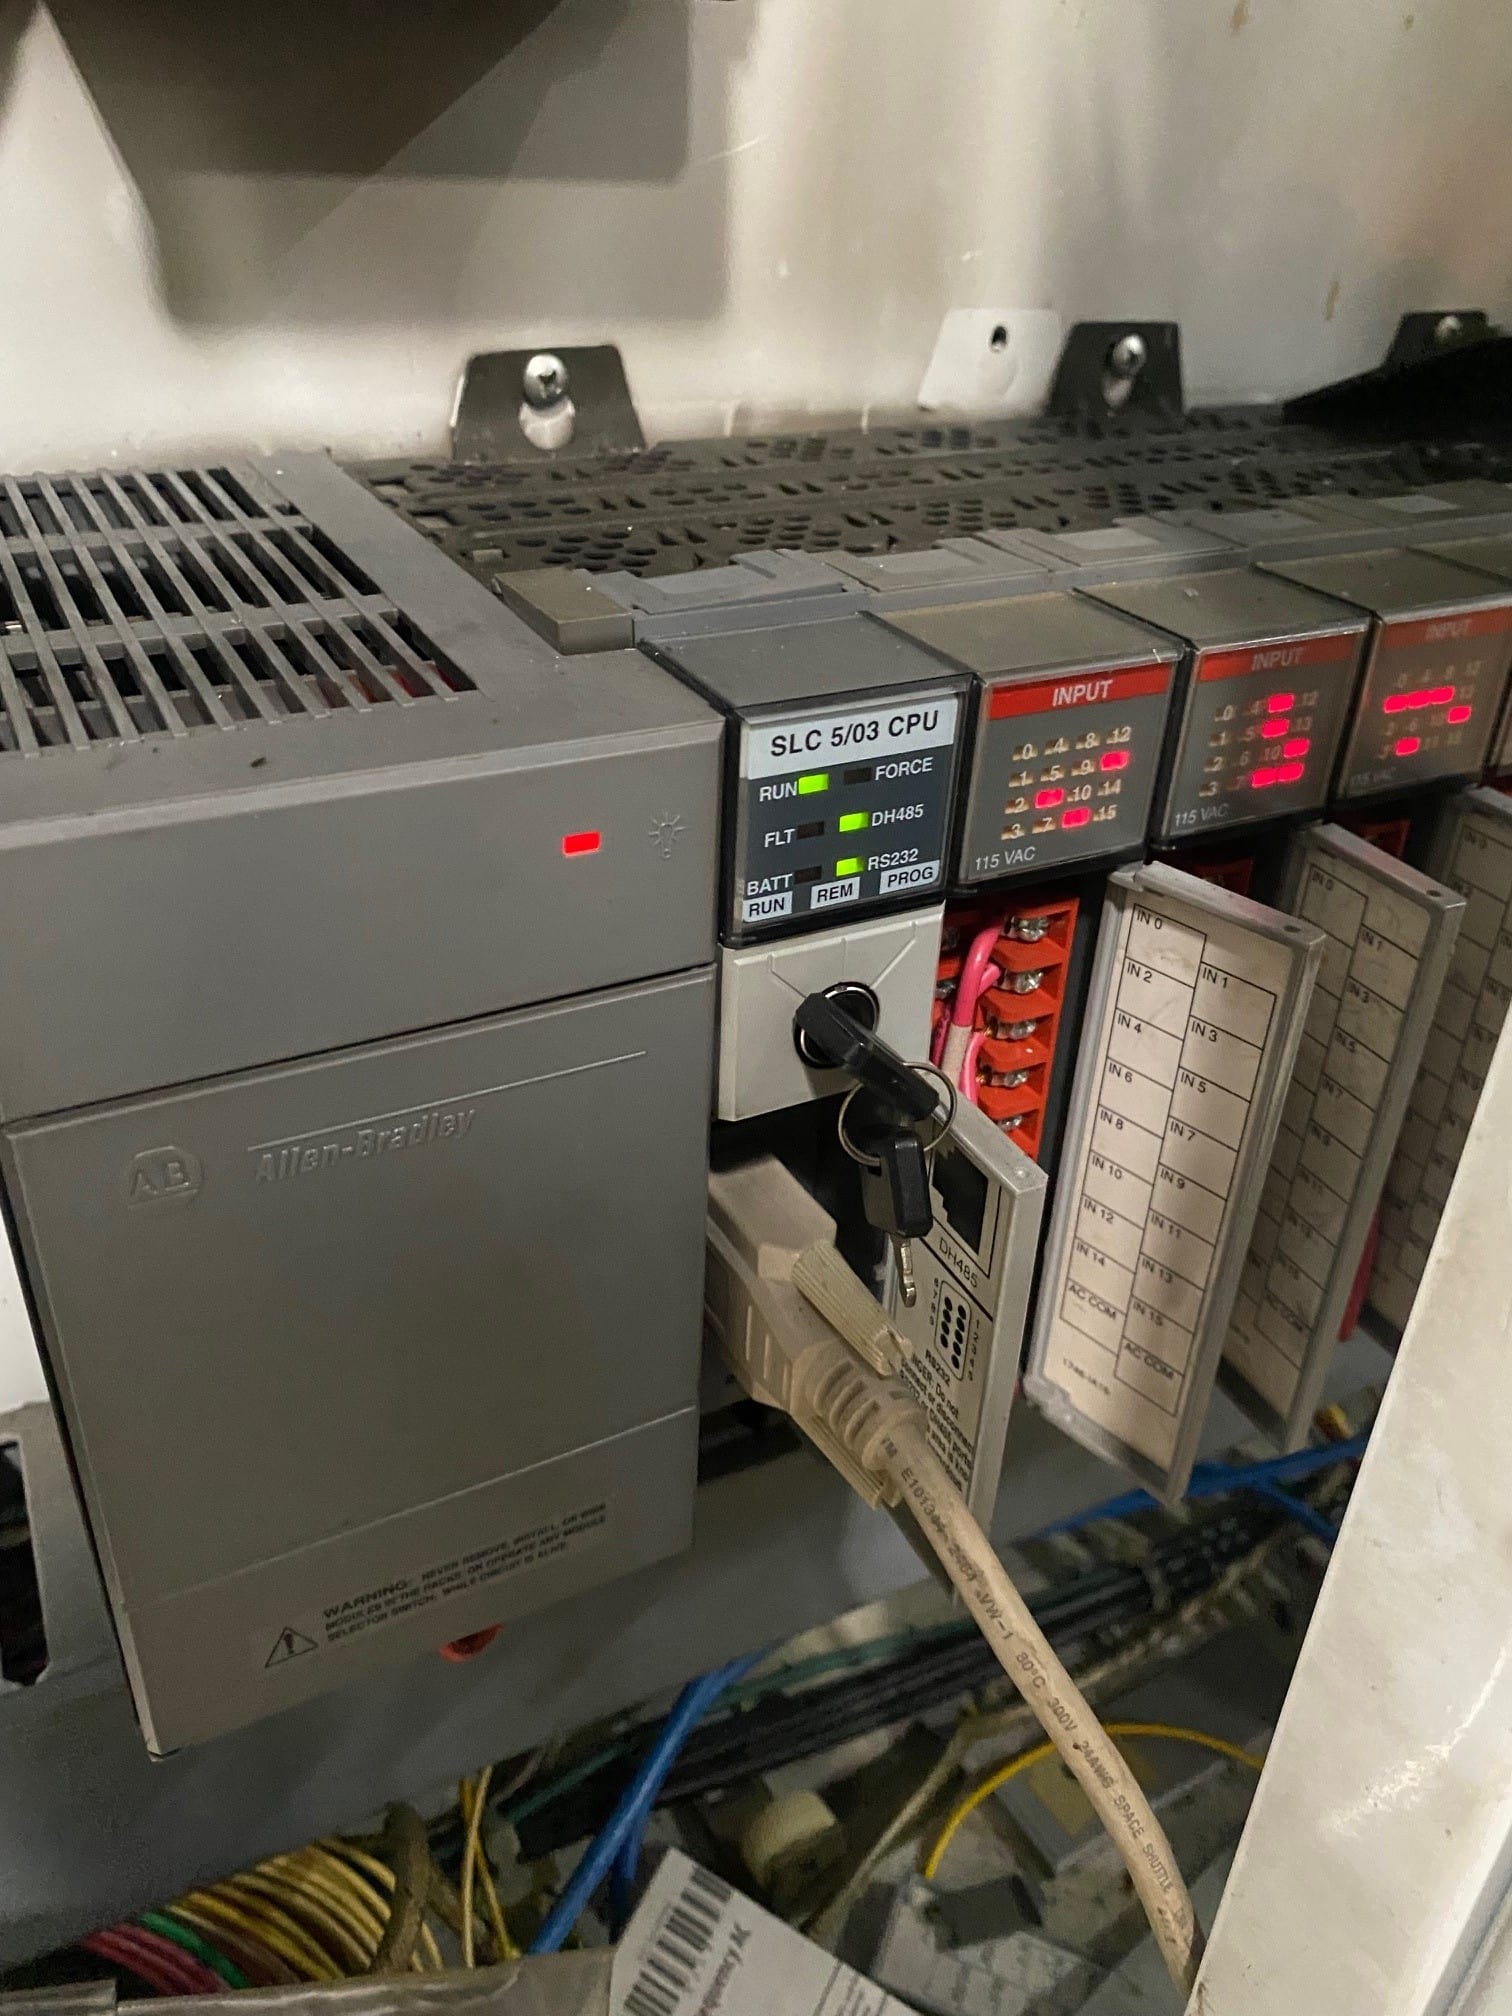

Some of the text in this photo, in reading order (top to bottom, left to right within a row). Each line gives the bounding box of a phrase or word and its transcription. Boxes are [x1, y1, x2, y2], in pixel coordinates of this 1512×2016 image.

[1252, 647, 1304, 671] INPUT
[1052, 680, 1113, 707] INPUT
[1223, 705, 1234, 721] 0
[771, 710, 939, 756] SLC 5/03 CPU
[1022, 726, 1132, 760] 0 4 8 12
[875, 757, 933, 780] FORCE
[1050, 765, 1061, 781] 5
[1080, 759, 1090, 775] 9
[759, 781, 798, 802] RUN
[1014, 779, 1122, 813] 2 10 14
[871, 804, 924, 826] DH485
[1011, 805, 1117, 839] 3 7 15
[1175, 803, 1229, 826] 115 VAC
[764, 829, 795, 847] FLT
[867, 848, 918, 871] RS232
[975, 847, 1036, 871] 115 VAC
[747, 873, 792, 896] BATT
[887, 867, 933, 887] PROG
[817, 883, 853, 903] REM
[749, 898, 785, 917] RUN
[1137, 909, 1163, 931] IN 0
[1127, 961, 1153, 984] IN 2
[1202, 966, 1229, 989] IN 1
[1117, 1012, 1142, 1034] IN 4
[1191, 1020, 1218, 1043] IN 3
[1108, 1062, 1133, 1084] IN 6
[1180, 1071, 1207, 1094] IN 5
[1100, 1109, 1124, 1130] IN 8
[1170, 1121, 1196, 1141] IN 7
[255, 1107, 476, 1184] Allen-Bradley
[129, 1160, 190, 1198] AB
[1092, 1155, 1122, 1180] IN 10
[1160, 1168, 1185, 1190] IN 9
[1084, 1199, 1114, 1224] IN 12
[1151, 1213, 1181, 1239] IN 11
[940, 1237, 978, 1288] DH485
[1076, 1242, 1105, 1266] IN 14
[1142, 1258, 1173, 1284] IN 13
[1069, 1285, 1116, 1320] AC COM
[1133, 1302, 1145, 1315] IN
[1144, 1356, 1174, 1380] COM
[936, 1383, 945, 1402] Do
[947, 1399, 958, 1420] not
[978, 1592, 1014, 1640] VW-1
[1048, 1697, 1078, 1732] 300V
[1113, 1794, 1145, 1839] SPACE
[1142, 1843, 1174, 1893] SHUTTLE
